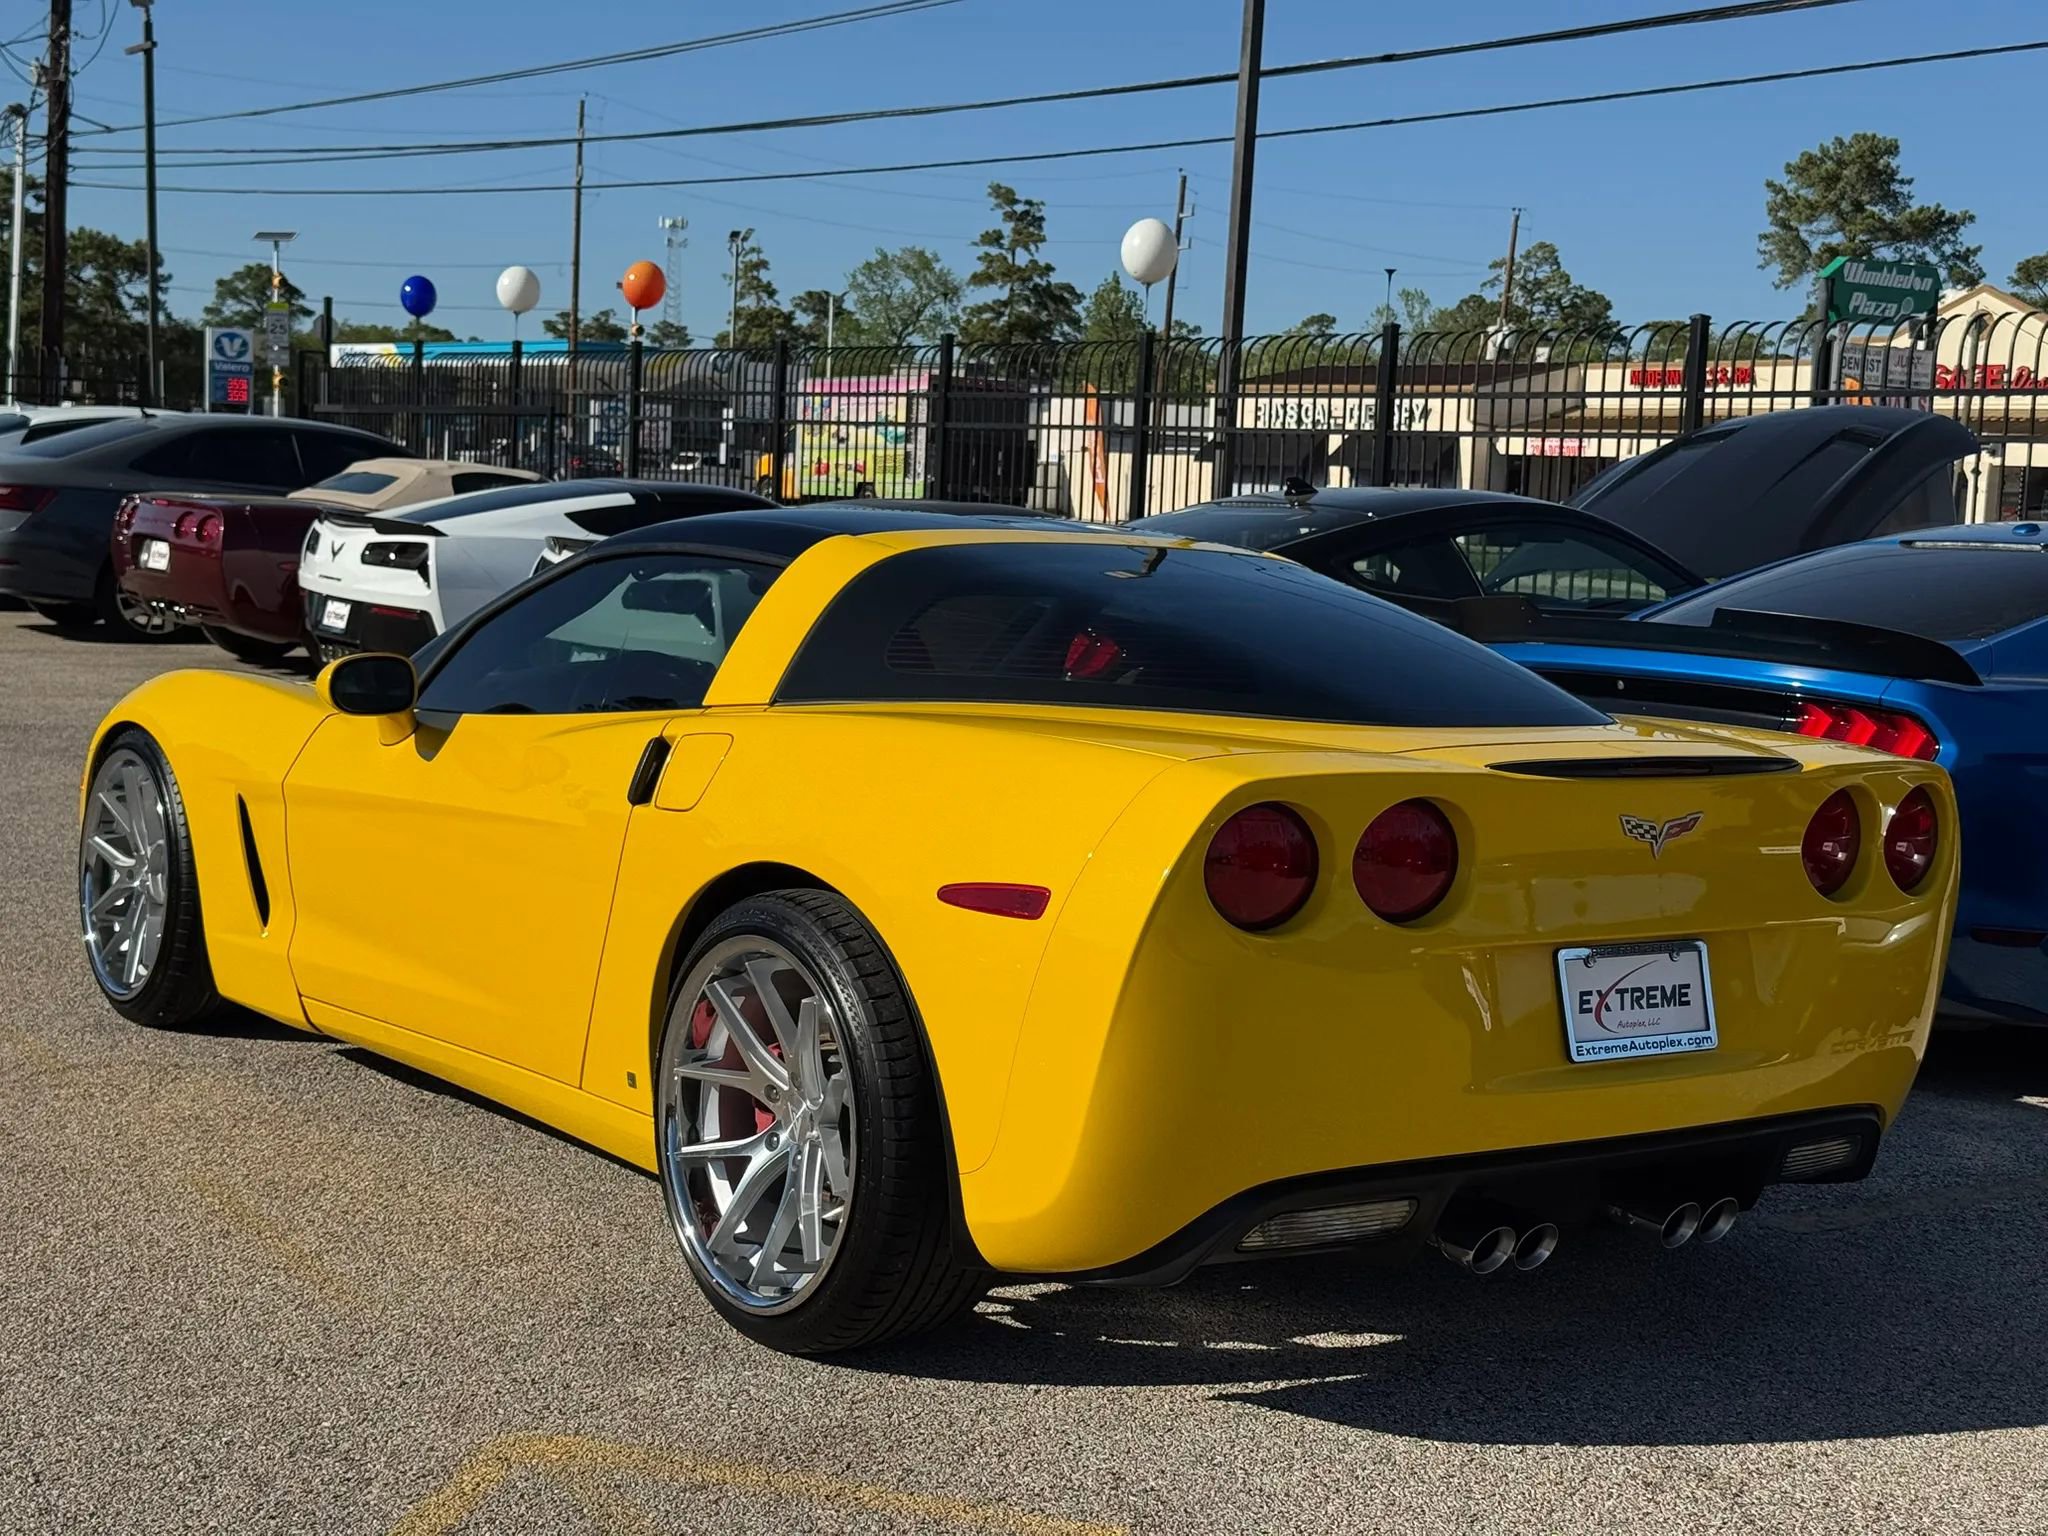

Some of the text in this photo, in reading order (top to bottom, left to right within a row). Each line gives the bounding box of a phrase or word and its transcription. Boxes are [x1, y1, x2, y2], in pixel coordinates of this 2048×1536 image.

[1843, 261, 1933, 291] Wimbledon
[1848, 291, 1898, 317] Plaza
[270, 323, 287, 334] 25
[214, 362, 250, 372] Valero
[1578, 983, 1691, 1014] EXTREME
[1648, 1017, 1661, 1026] LLC
[1576, 1035, 1713, 1057] ExtremeAutoplex.com
